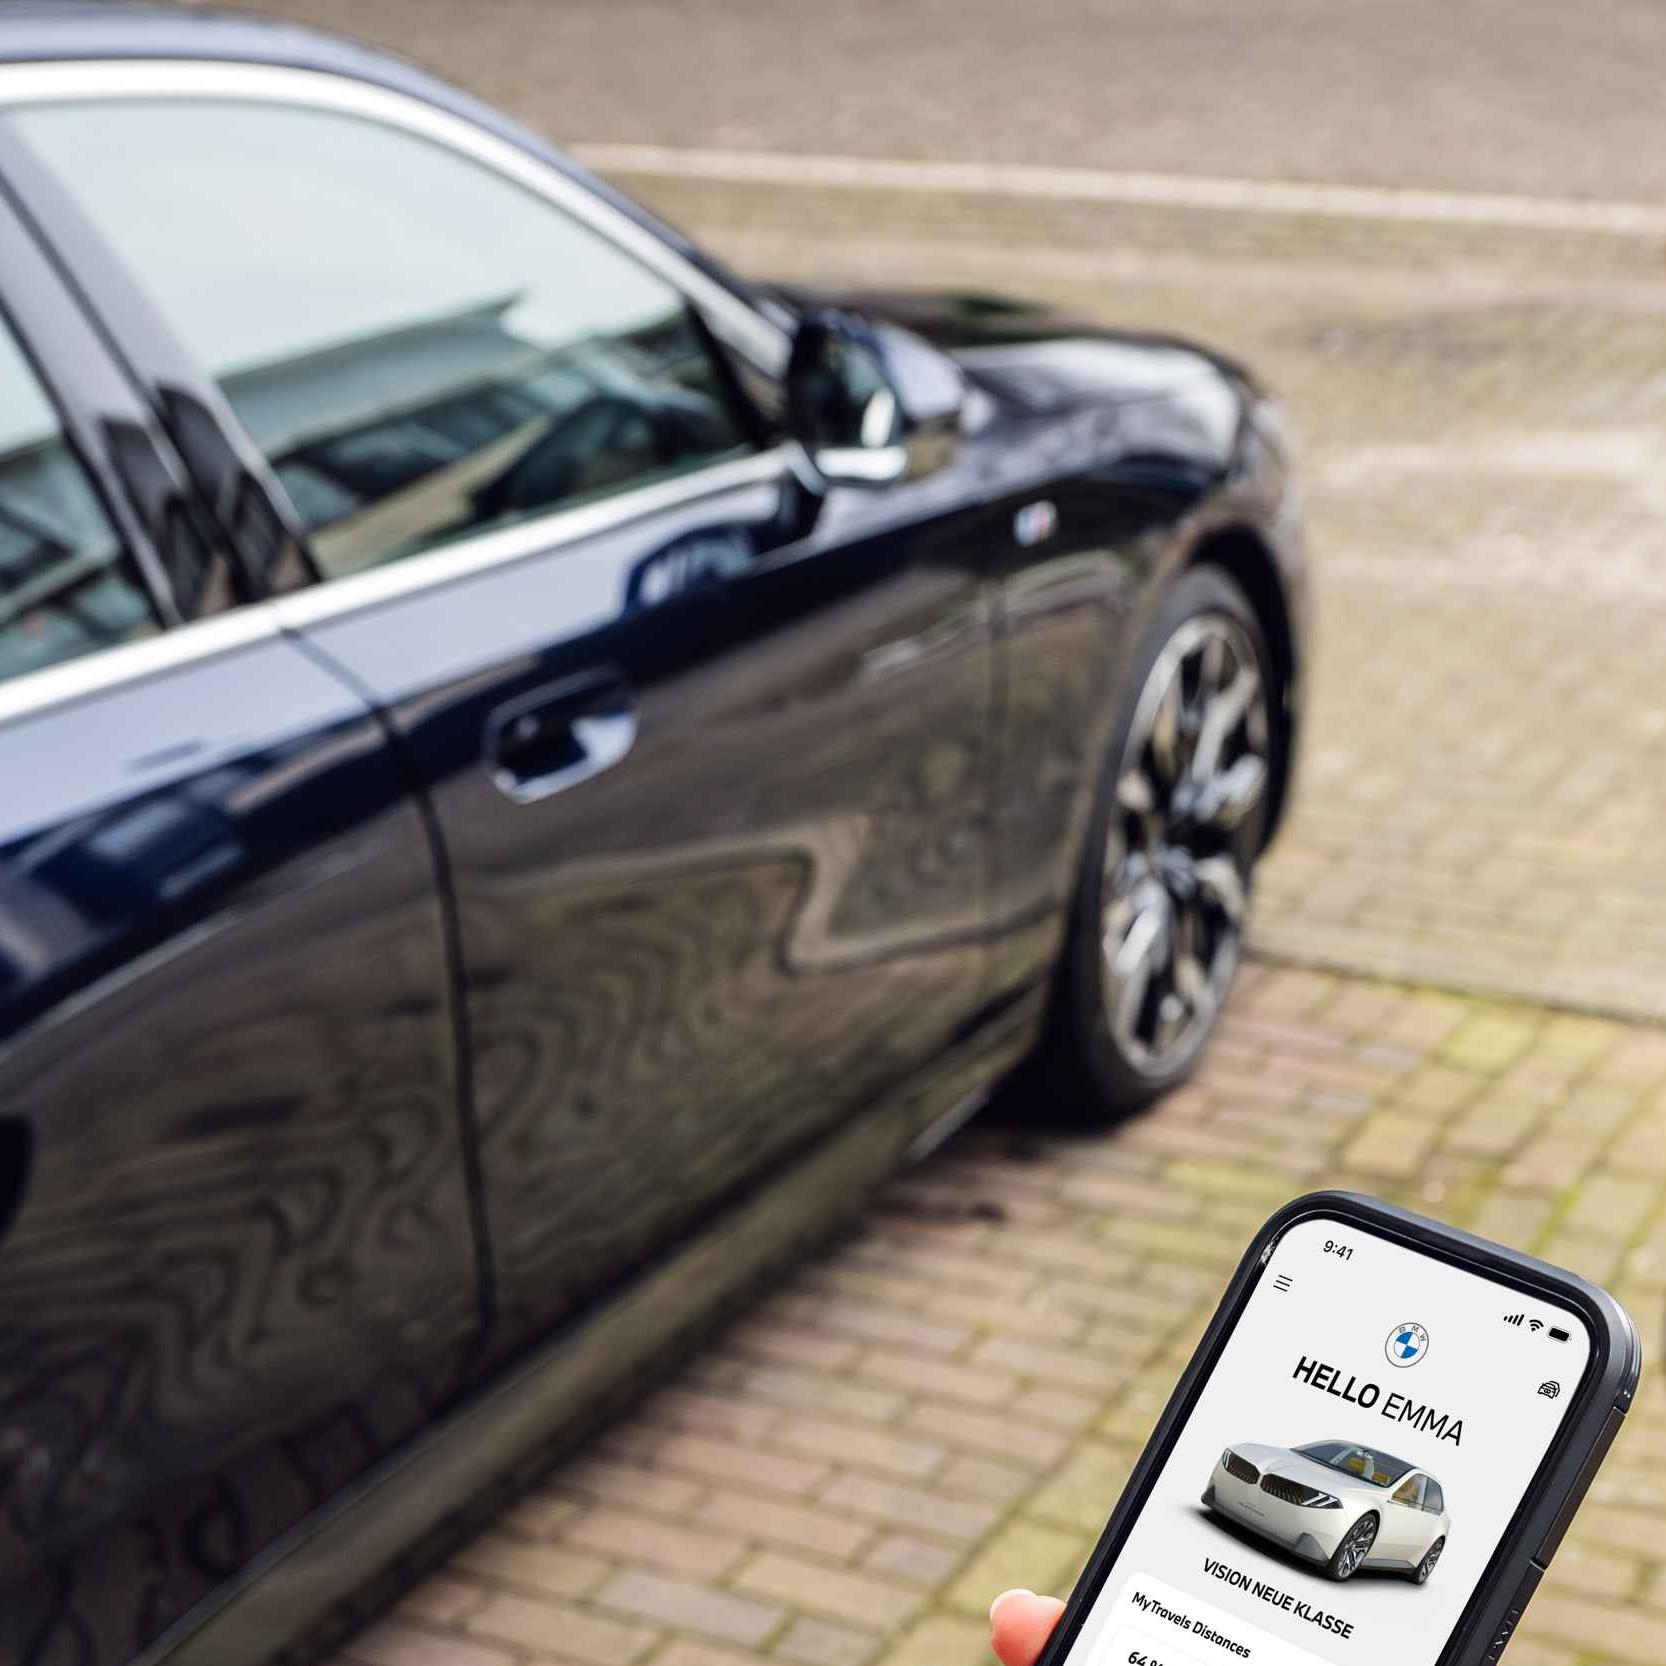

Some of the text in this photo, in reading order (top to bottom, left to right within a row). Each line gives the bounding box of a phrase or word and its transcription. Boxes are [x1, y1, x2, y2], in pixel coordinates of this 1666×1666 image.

[1323, 1240, 1353, 1261] 9:41
[1292, 1356, 1463, 1446] HELLO EMMA
[1131, 1591, 1251, 1658] MyTravels Distances
[1204, 1557, 1354, 1639] VISION NEUE KLASSE
